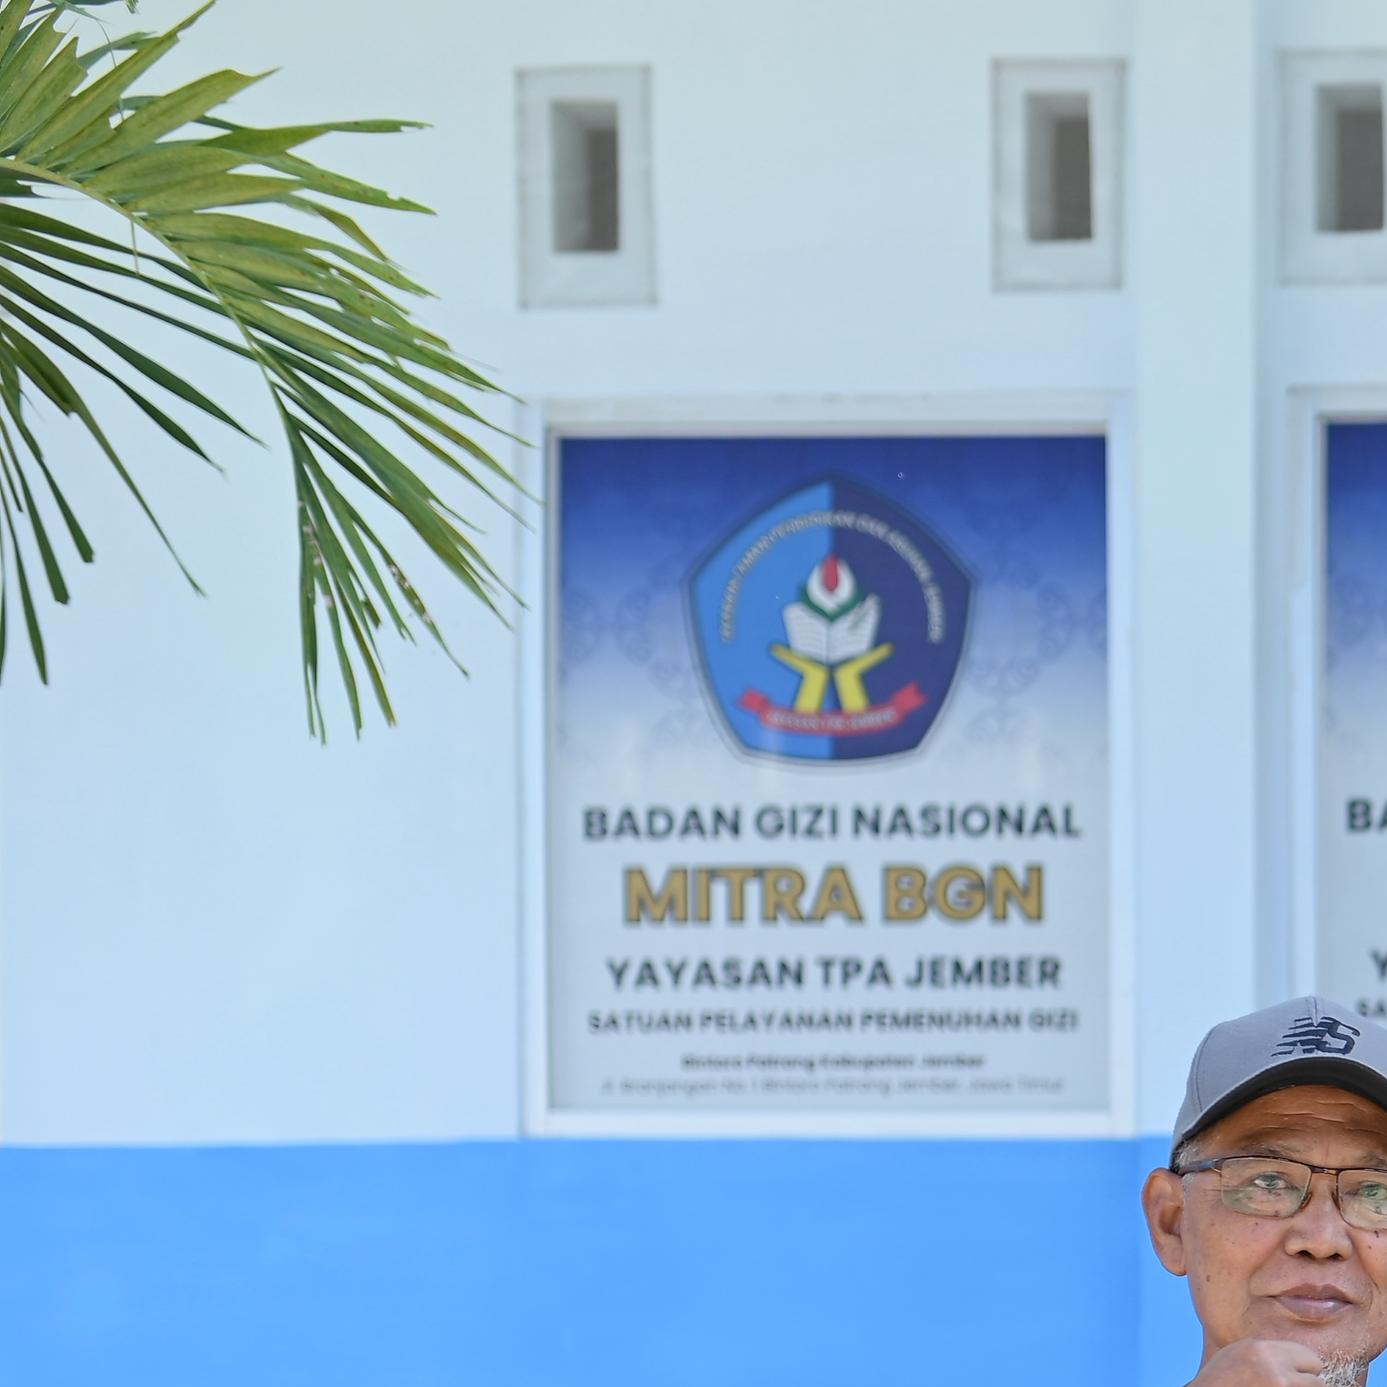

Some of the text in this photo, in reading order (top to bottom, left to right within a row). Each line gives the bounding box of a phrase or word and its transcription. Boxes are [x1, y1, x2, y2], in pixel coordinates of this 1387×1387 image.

[583, 803, 1079, 841] BADAN GIZI NASIONAL
[623, 863, 1044, 924] MITRA BGN
[607, 957, 1062, 989] YAYASAN TPA JEMBER
[587, 1010, 1079, 1034] SATUAN PELAYANAN PEMENUHAN GIZI
